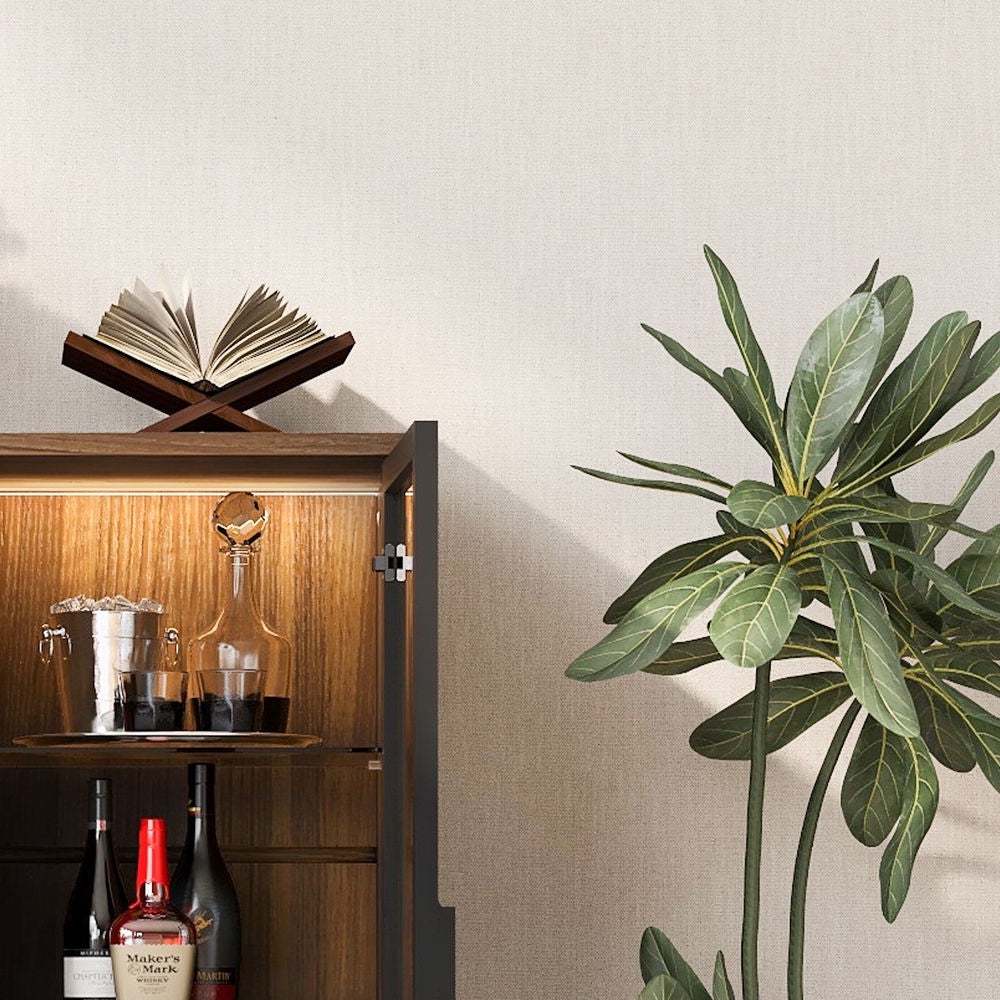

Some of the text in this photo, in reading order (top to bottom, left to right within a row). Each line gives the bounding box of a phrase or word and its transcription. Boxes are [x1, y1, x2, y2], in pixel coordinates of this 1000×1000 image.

[127, 954, 180, 963] Maker's
[142, 965, 178, 973] Mark
[197, 971, 230, 980] MARTIN
